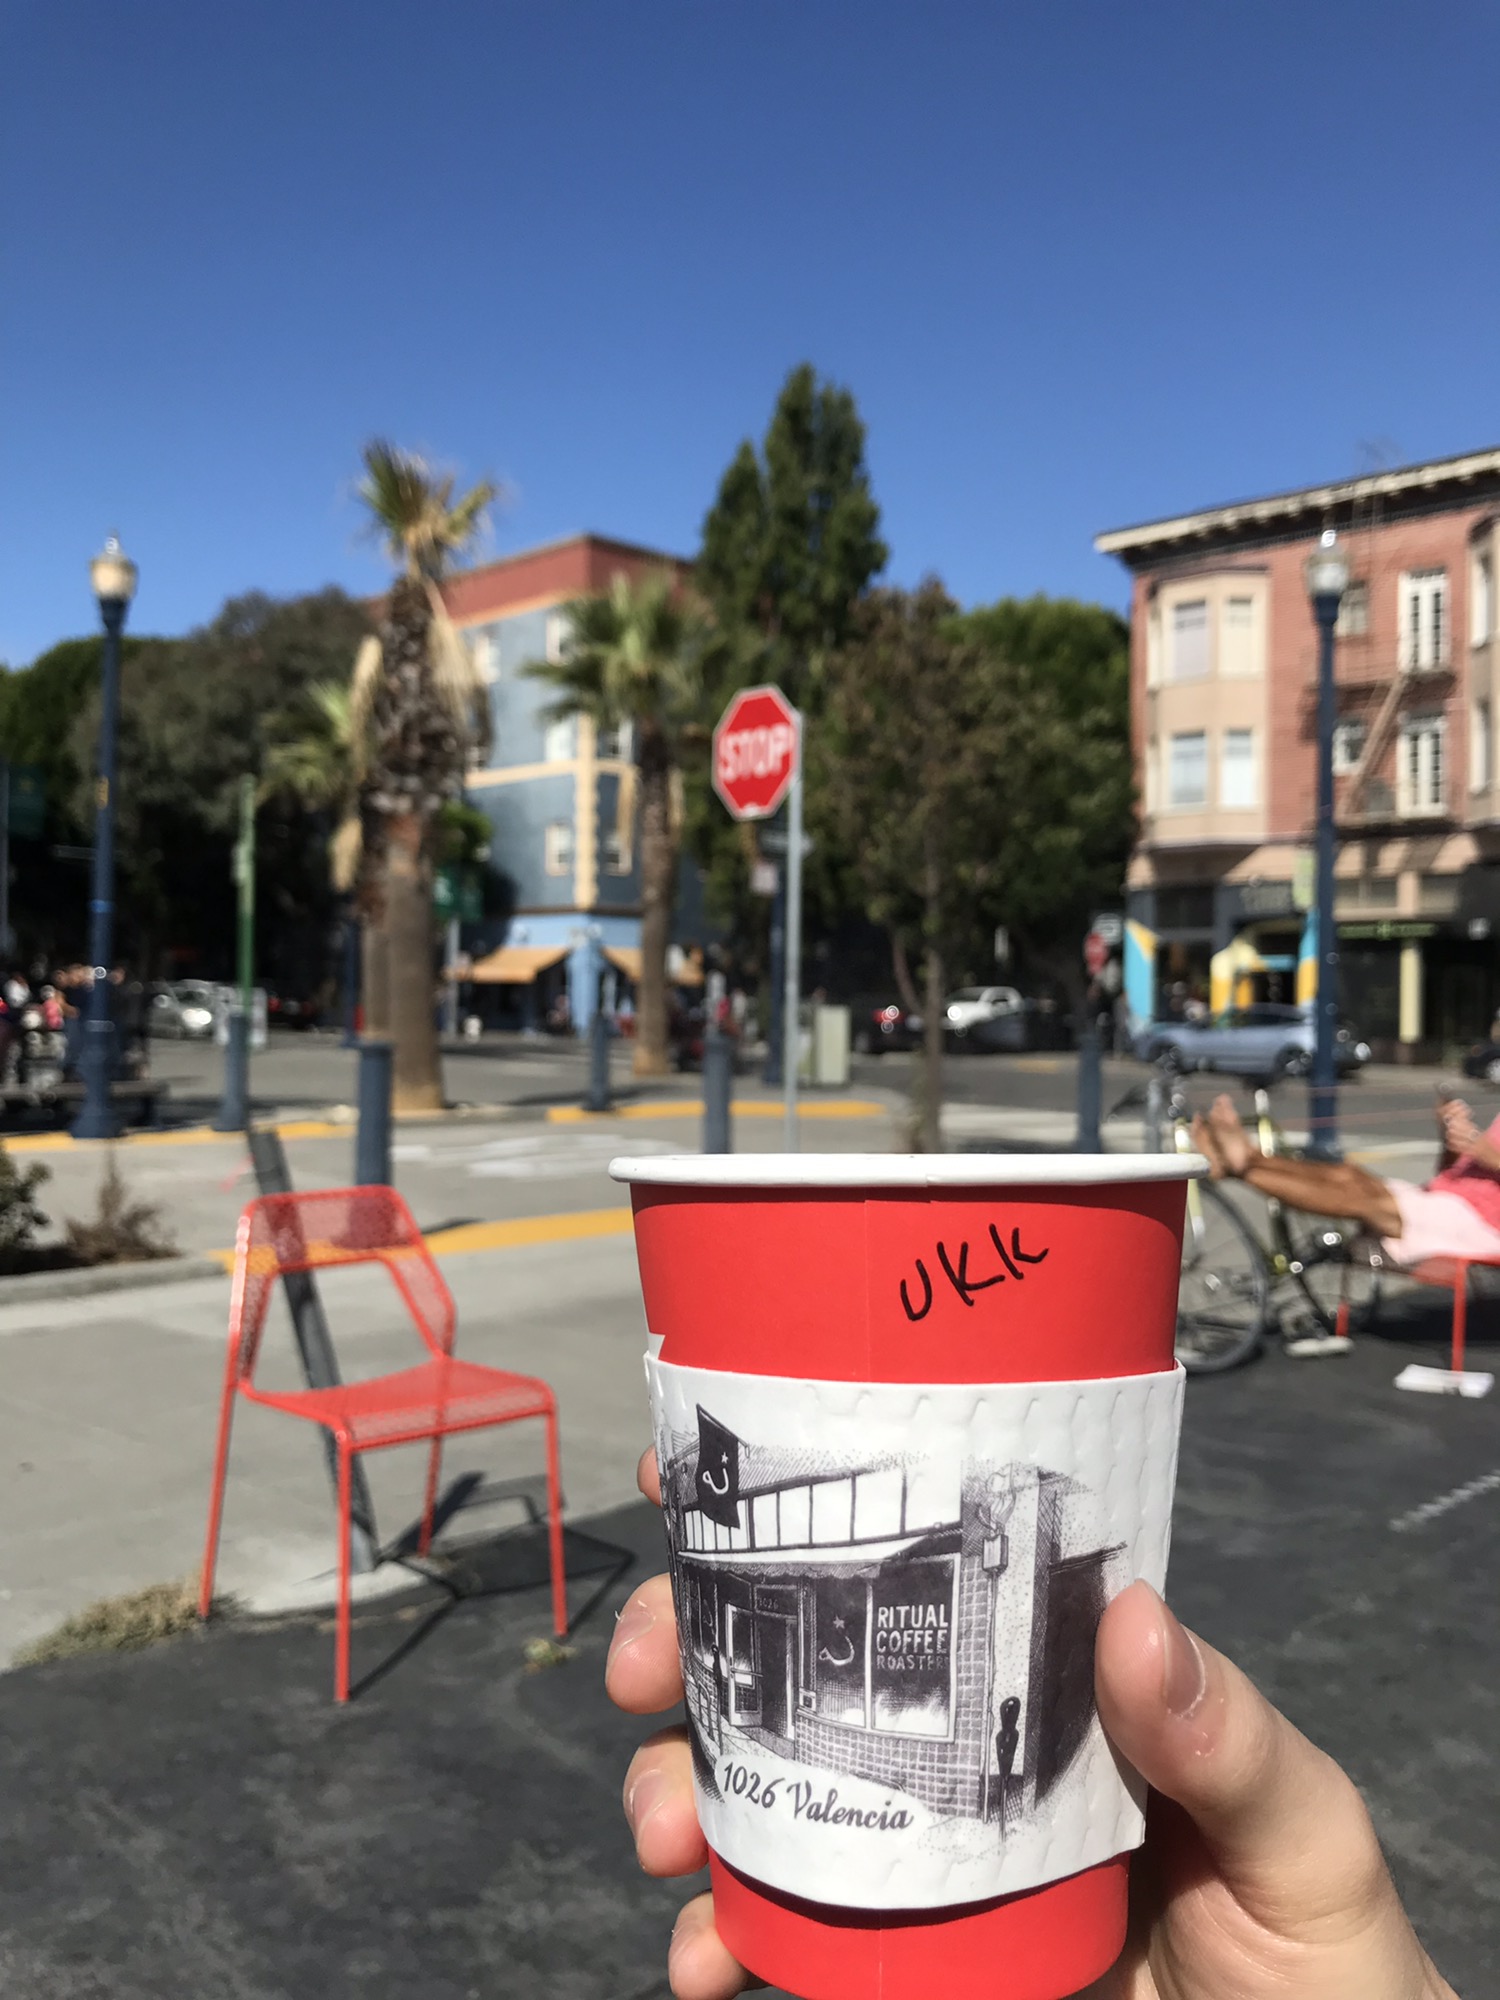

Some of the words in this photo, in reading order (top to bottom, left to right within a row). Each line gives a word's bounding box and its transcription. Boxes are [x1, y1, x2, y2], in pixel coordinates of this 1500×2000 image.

[719, 724, 794, 782] STOP
[877, 1603, 949, 1628] RITUAL
[876, 1629, 948, 1653] COFFEE
[724, 1761, 786, 1808] 1026
[786, 1779, 915, 1830] Valencia
